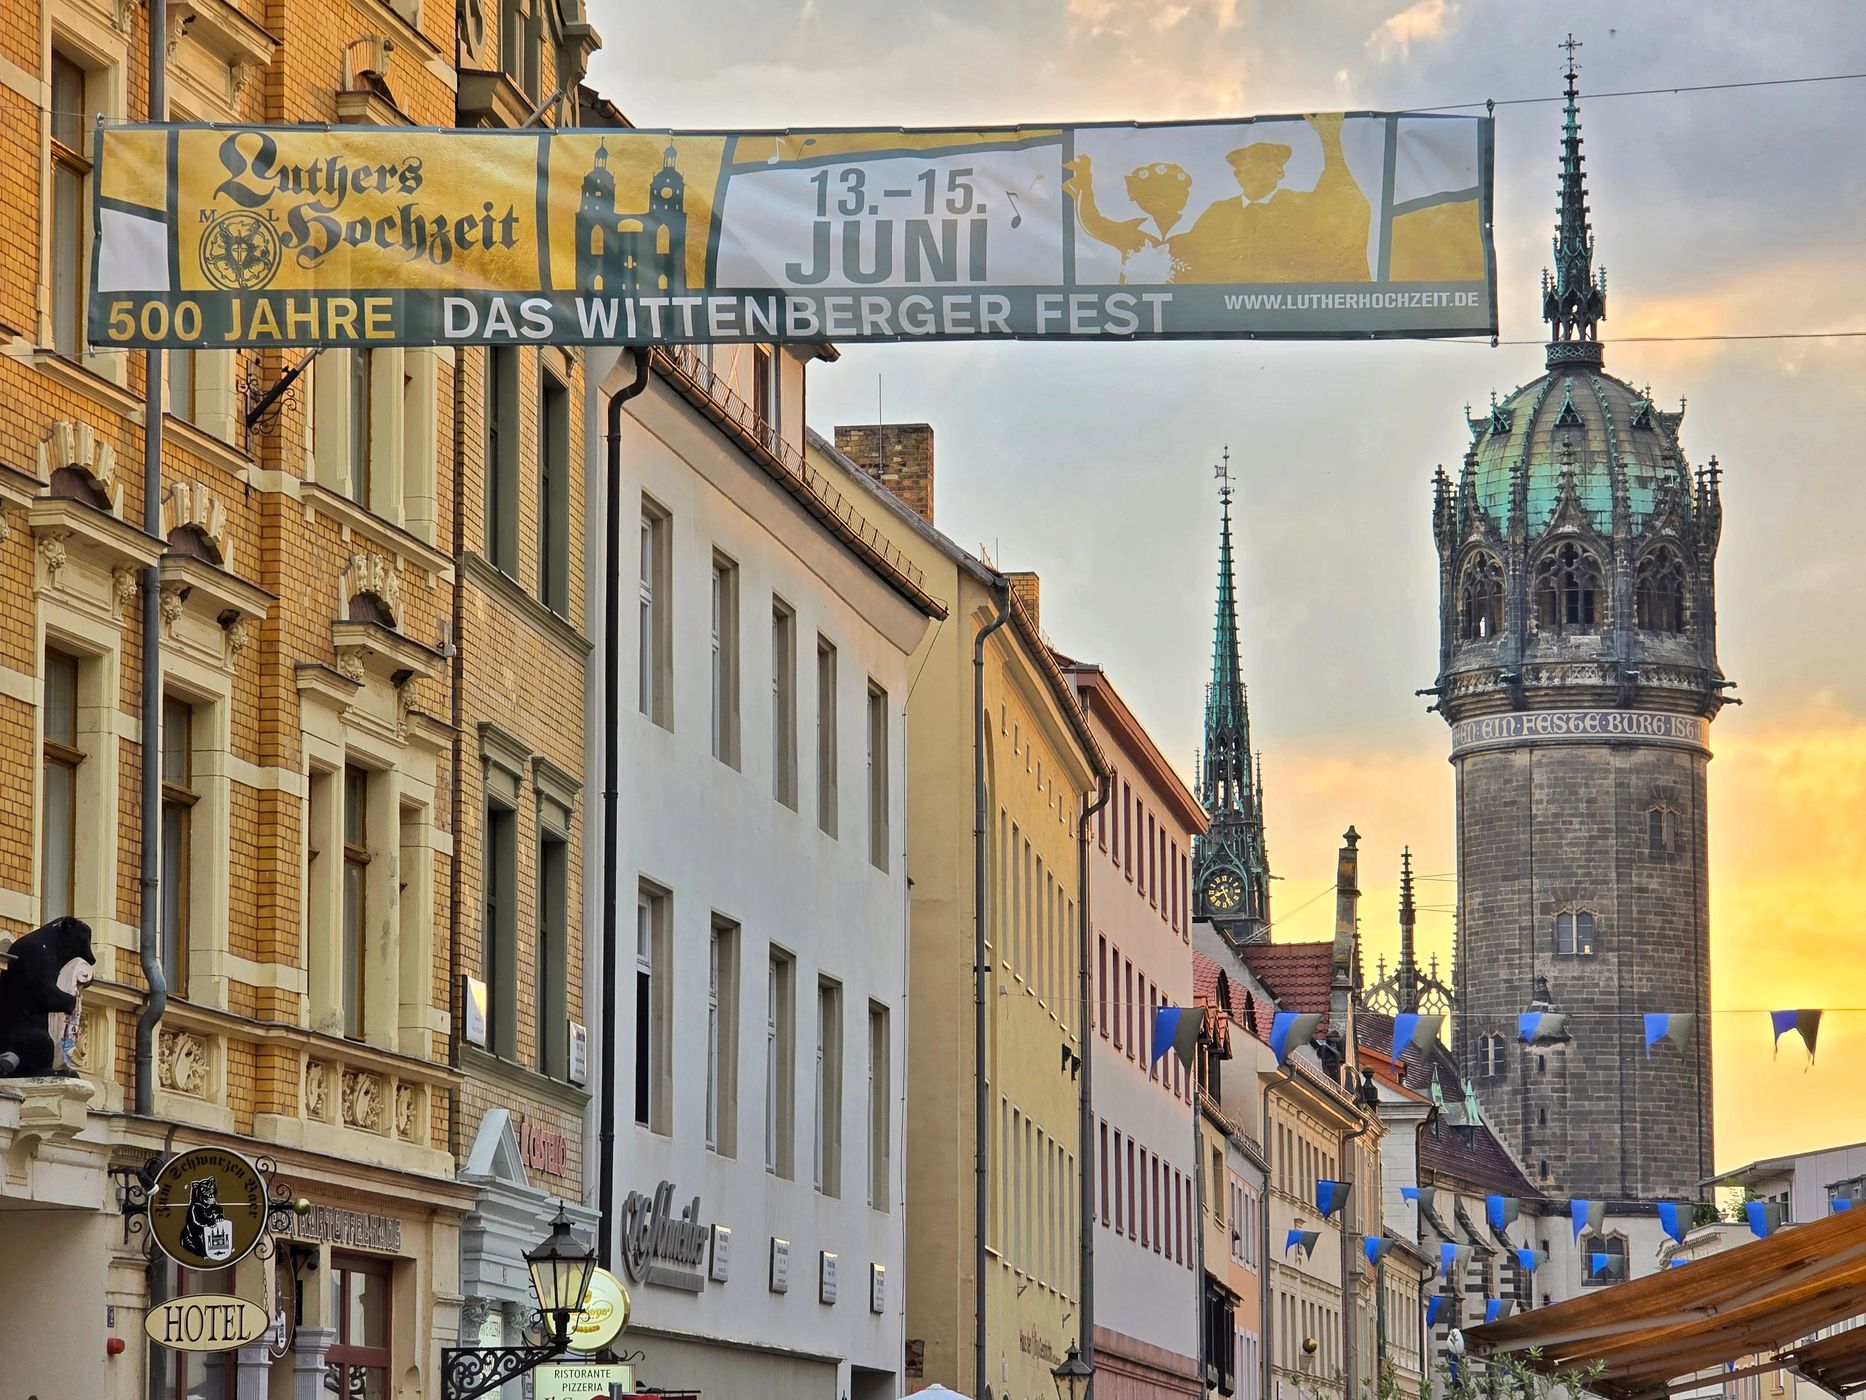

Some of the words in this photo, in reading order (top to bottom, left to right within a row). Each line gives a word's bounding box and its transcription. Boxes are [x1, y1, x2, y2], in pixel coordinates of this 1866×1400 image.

[213, 131, 423, 209] Luthers
[281, 201, 519, 269] Hochzeit
[785, 218, 988, 285] JUNI
[107, 300, 202, 341] 500
[224, 297, 395, 340] JAHRE
[443, 297, 553, 340] DAS
[574, 293, 1012, 339] WITTENBERGER
[1036, 292, 1173, 336] FEST
[1224, 291, 1480, 310] WWW.LUTHERHOCHZEIT.DE
[155, 1183, 172, 1218] Zum
[169, 1155, 245, 1180] Schwarzen
[244, 1178, 258, 1219] Baer
[163, 1304, 252, 1343] HOTEL
[554, 1369, 611, 1379] RISTORANTE
[562, 1382, 604, 1392] PIZZERIA
